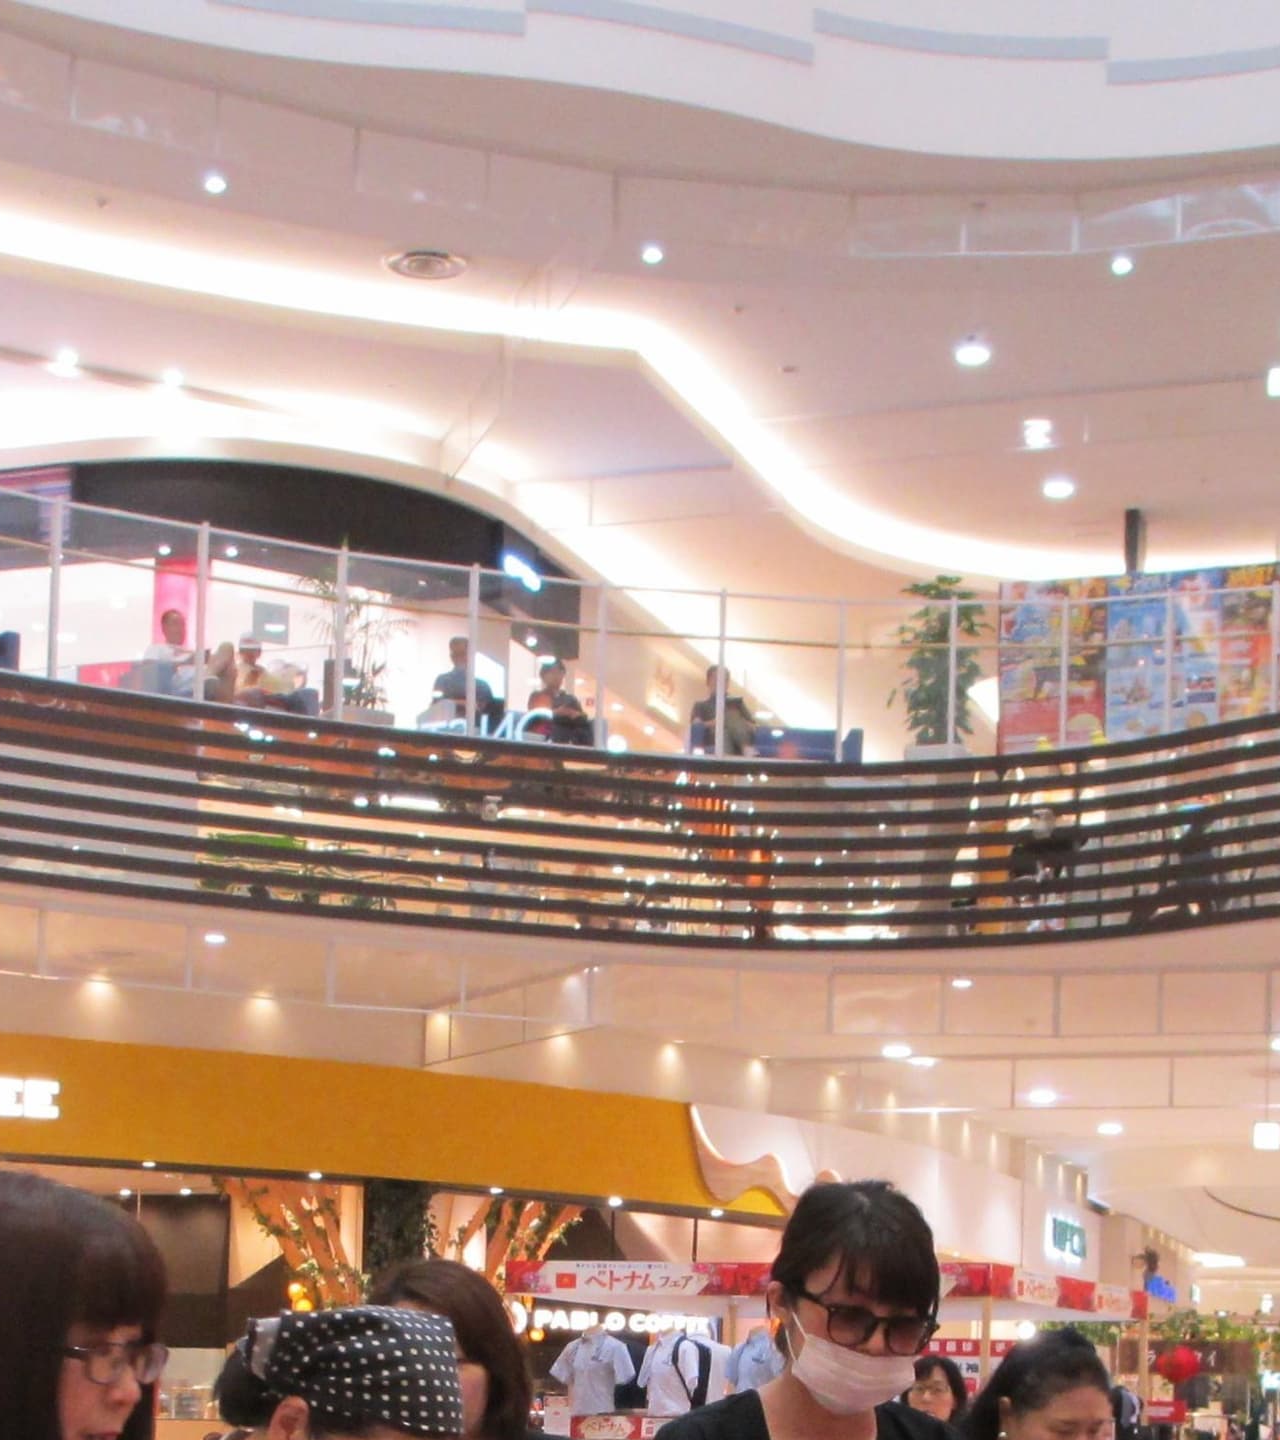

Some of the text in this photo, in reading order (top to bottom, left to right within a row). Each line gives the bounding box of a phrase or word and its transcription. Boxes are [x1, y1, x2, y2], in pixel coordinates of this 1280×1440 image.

[584, 1269, 695, 1292] ベトナムフェア
